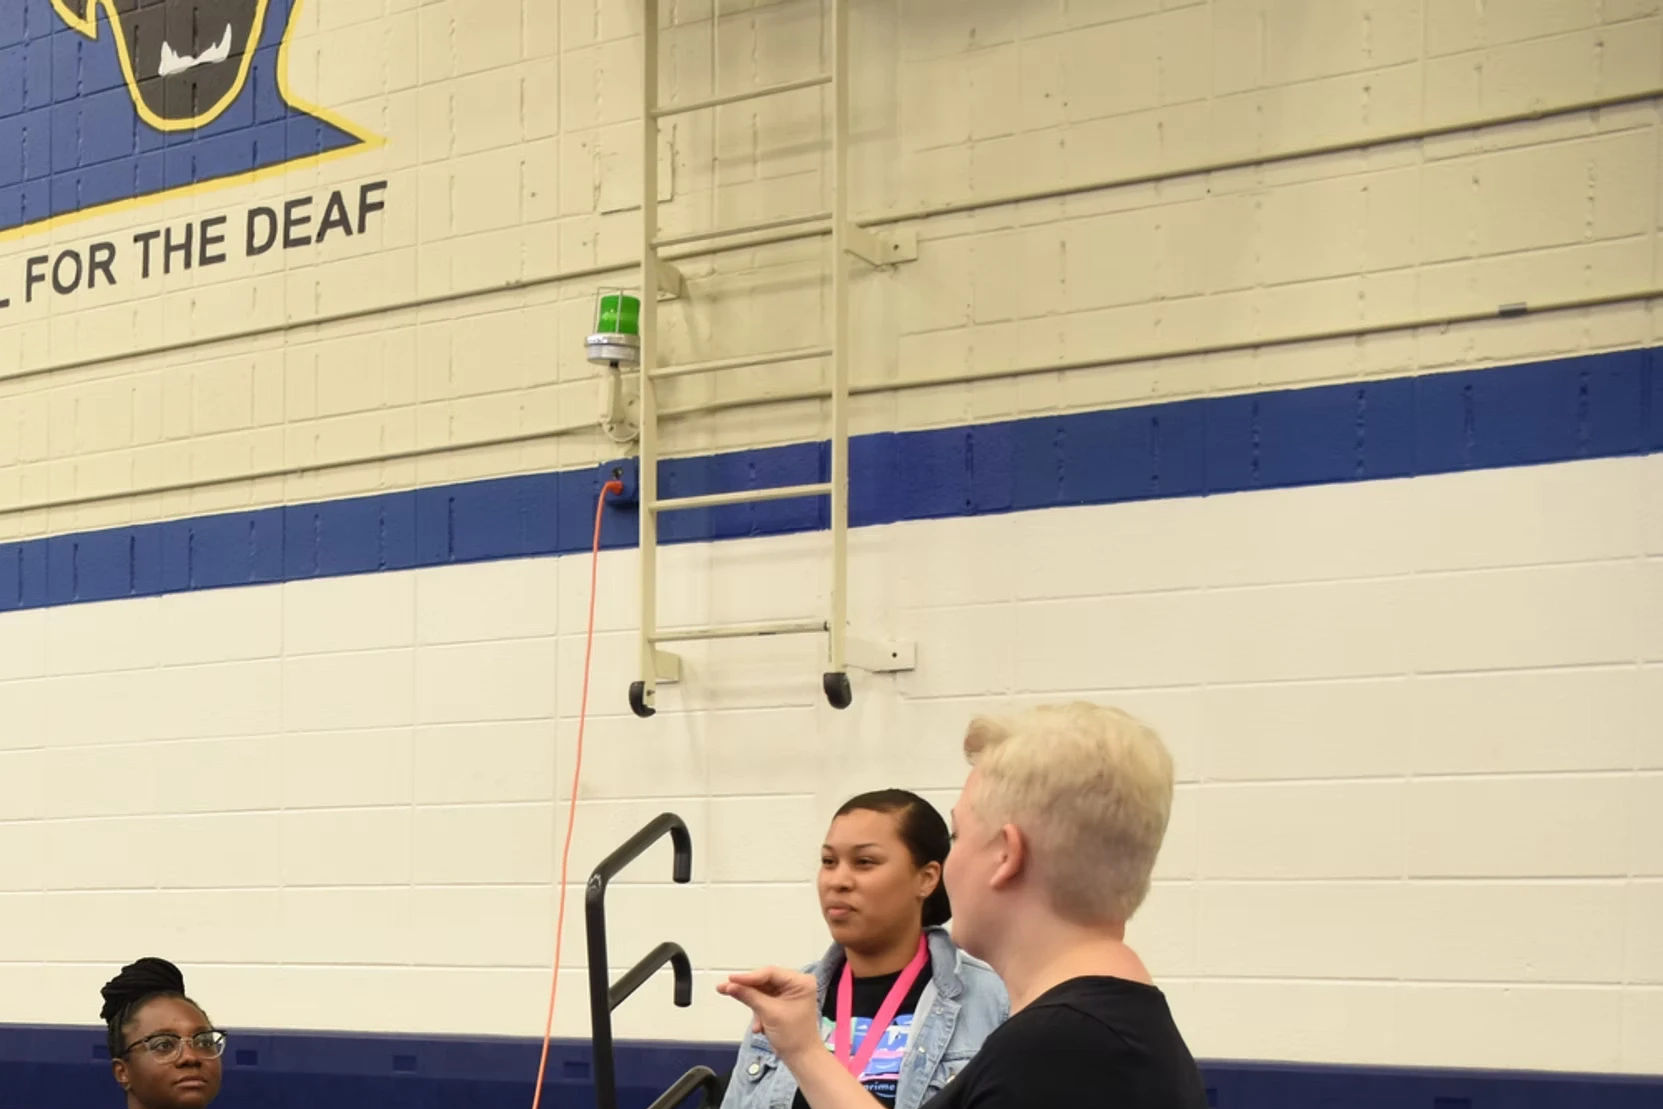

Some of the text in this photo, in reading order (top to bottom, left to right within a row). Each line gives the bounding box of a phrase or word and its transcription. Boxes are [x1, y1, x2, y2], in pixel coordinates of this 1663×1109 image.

[25, 241, 117, 303] FOR
[133, 215, 227, 279] THE
[246, 180, 388, 257] DEAF
